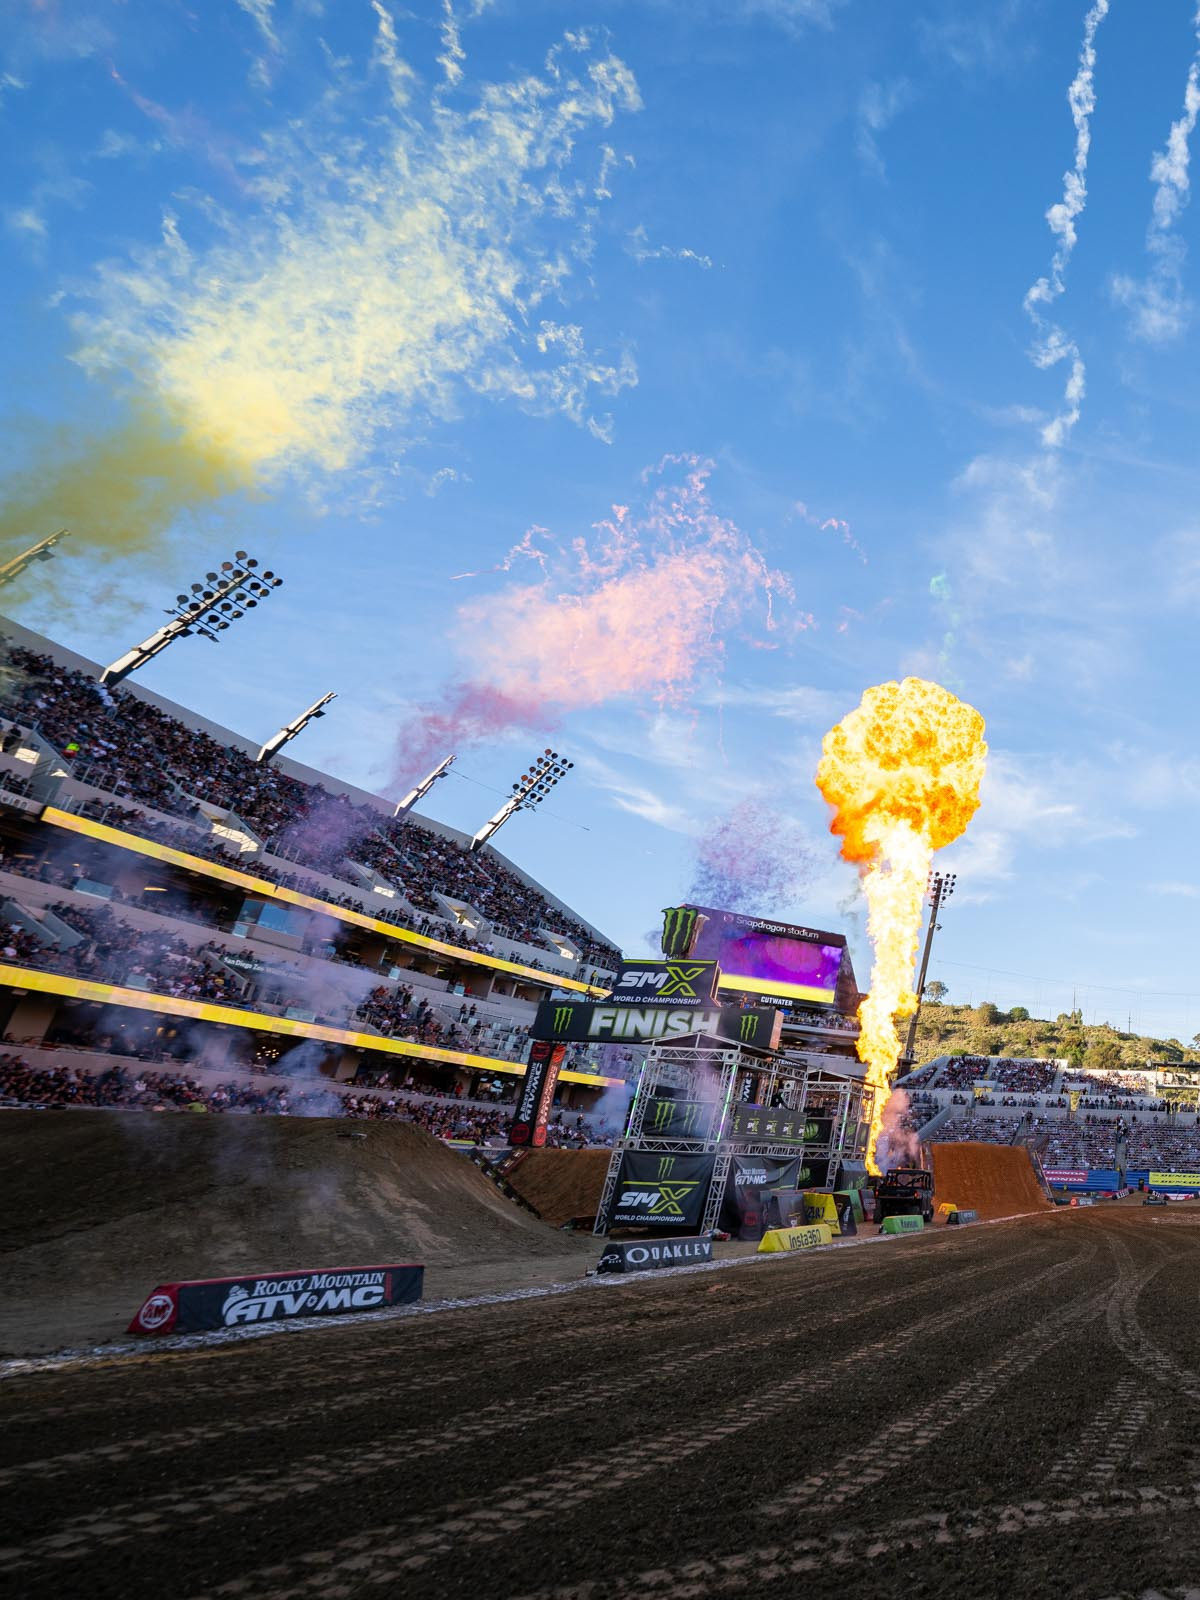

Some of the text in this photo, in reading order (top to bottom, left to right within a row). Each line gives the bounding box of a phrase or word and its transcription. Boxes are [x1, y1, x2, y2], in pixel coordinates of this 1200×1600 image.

[736, 916, 819, 940] Snapdragon stadium
[223, 956, 235, 965] San
[235, 959, 253, 970] Diego
[617, 966, 706, 997] SMX
[613, 995, 702, 1005] WORLD CHAMPIONSHIP
[761, 996, 793, 1006] CUTWATER
[587, 1007, 721, 1038] FINISH
[617, 1187, 693, 1215] SMX
[635, 1215, 686, 1223] CHAMPIONSHIP
[788, 1229, 822, 1249] Insta360
[651, 1243, 711, 1260] OAKLEY
[251, 1278, 305, 1297] ROCKY
[307, 1272, 385, 1290] MOUNTAIN
